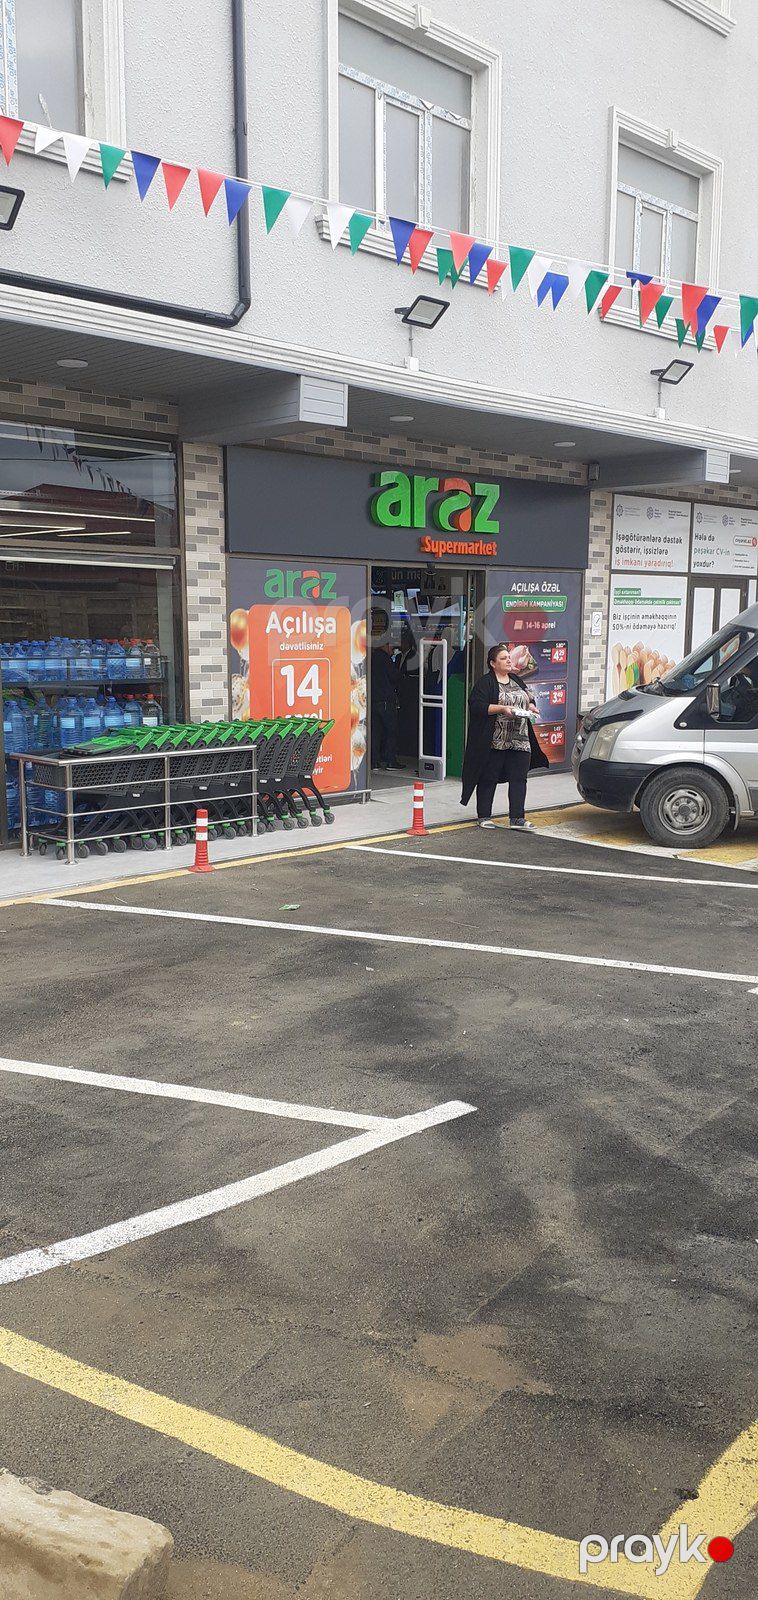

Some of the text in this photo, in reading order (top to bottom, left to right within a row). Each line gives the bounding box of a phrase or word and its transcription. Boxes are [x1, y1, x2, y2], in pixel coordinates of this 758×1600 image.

[371, 470, 500, 533] araz
[420, 535, 497, 558] Supermarket
[263, 568, 337, 599] araz
[510, 581, 561, 594] AÇILIŞA ÖZƏL
[265, 610, 337, 639] Açılışa
[541, 621, 556, 631] aprel
[612, 613, 622, 621] Biz
[279, 642, 324, 651] dəvətlisiniz
[280, 664, 323, 707] 14
